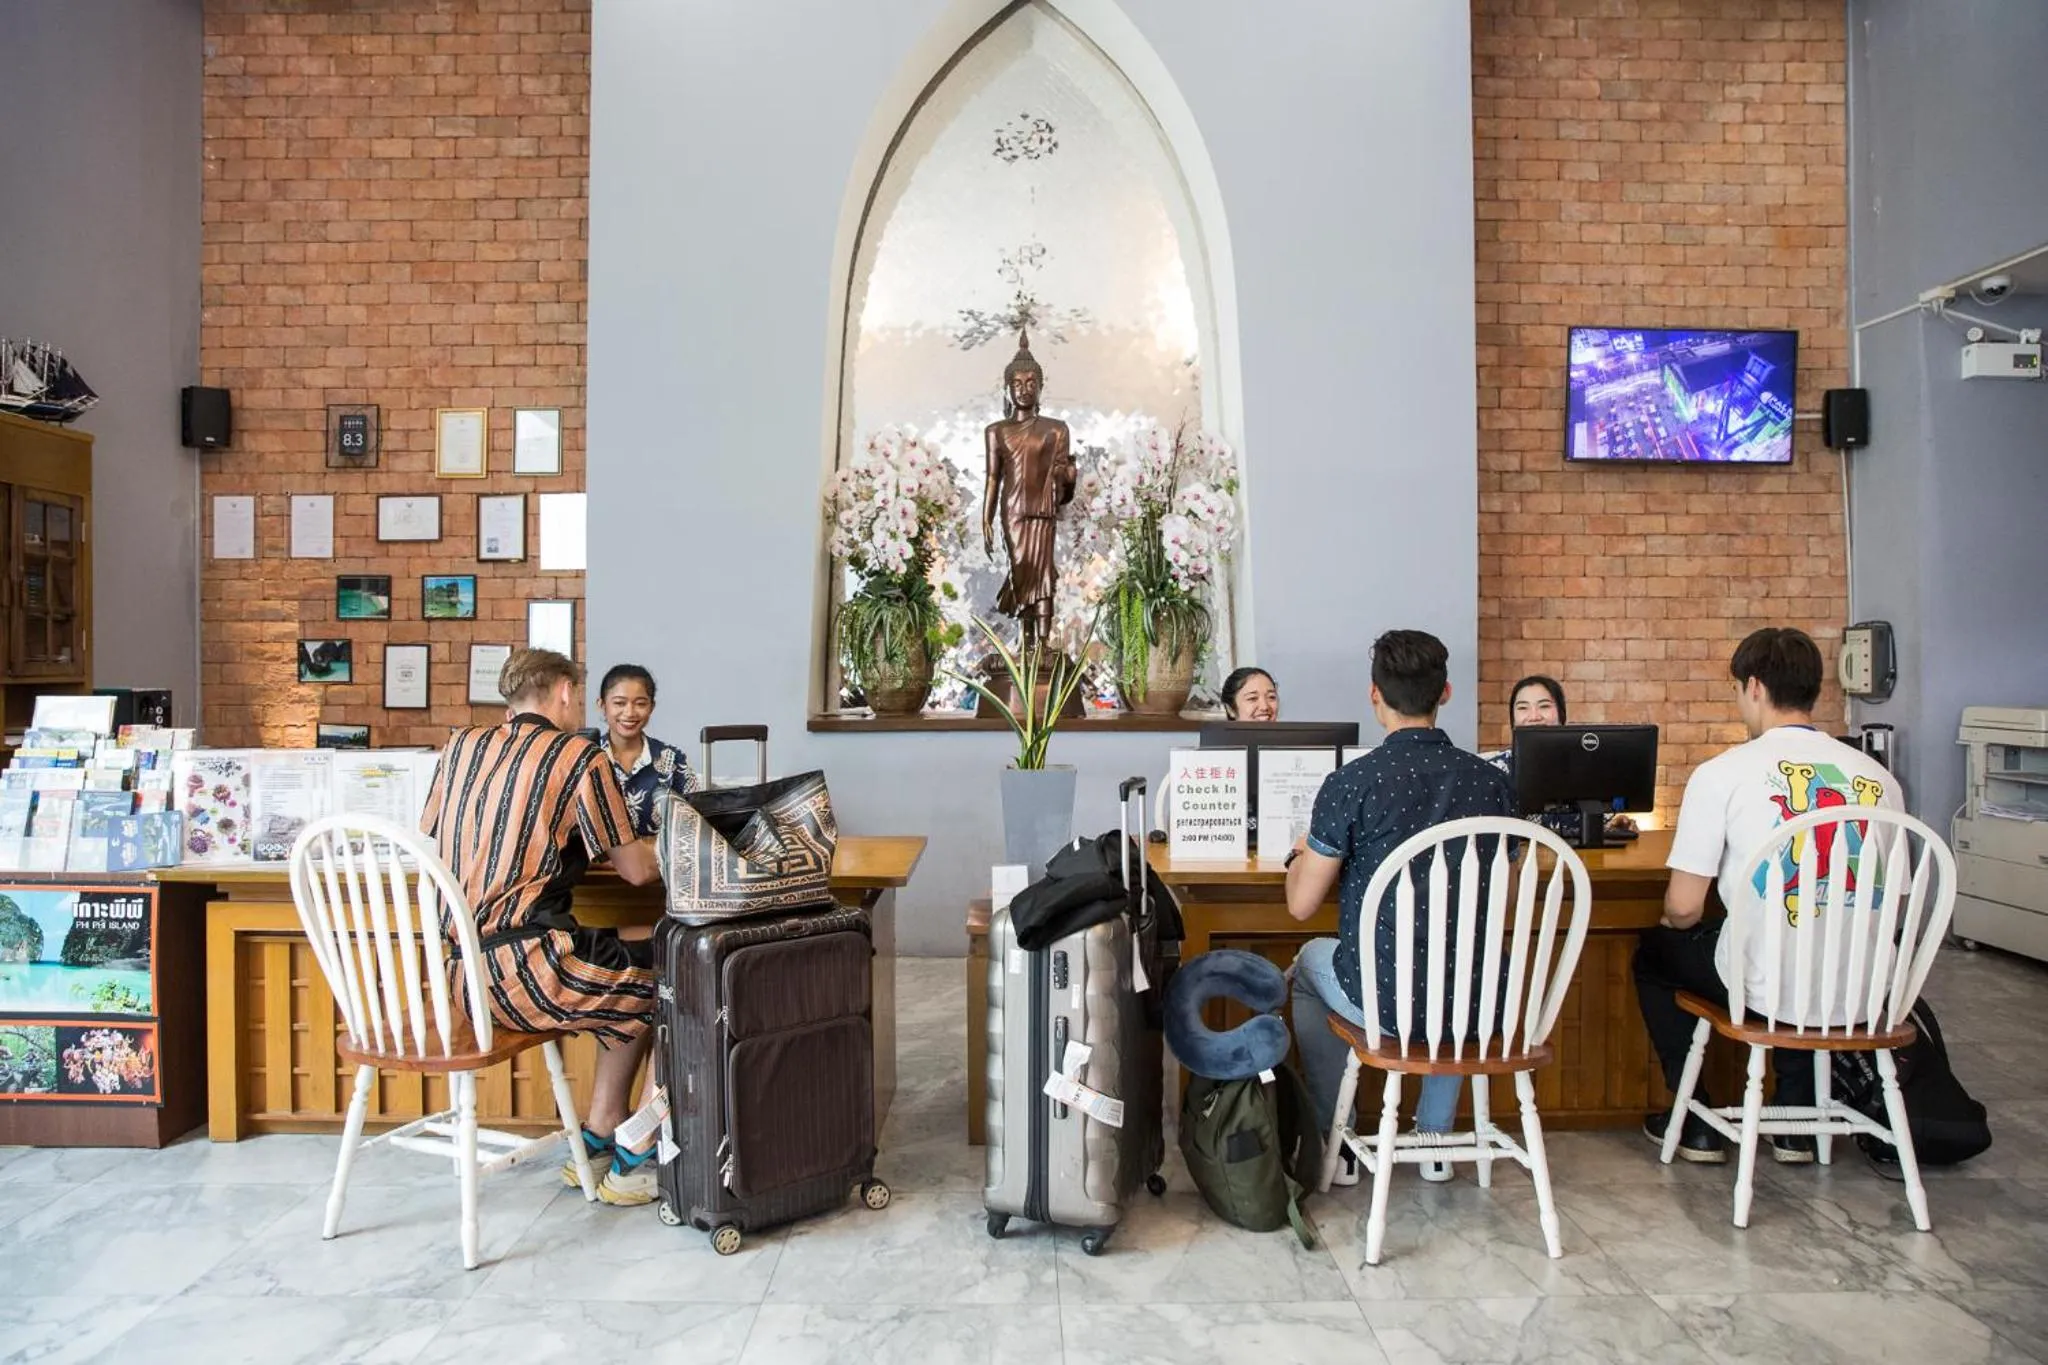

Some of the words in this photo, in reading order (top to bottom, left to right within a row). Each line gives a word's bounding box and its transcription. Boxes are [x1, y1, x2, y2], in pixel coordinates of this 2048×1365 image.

[343, 433, 363, 446] 8.3
[1177, 784, 1219, 794] Check
[1225, 784, 1237, 794] In
[1182, 801, 1237, 811] Counter
[1176, 818, 1242, 829] регистрироваться
[1182, 834, 1196, 842] 2:00
[1198, 834, 1209, 842] PM
[73, 897, 144, 919] เกาะพีพี
[109, 921, 140, 930] ISLAND
